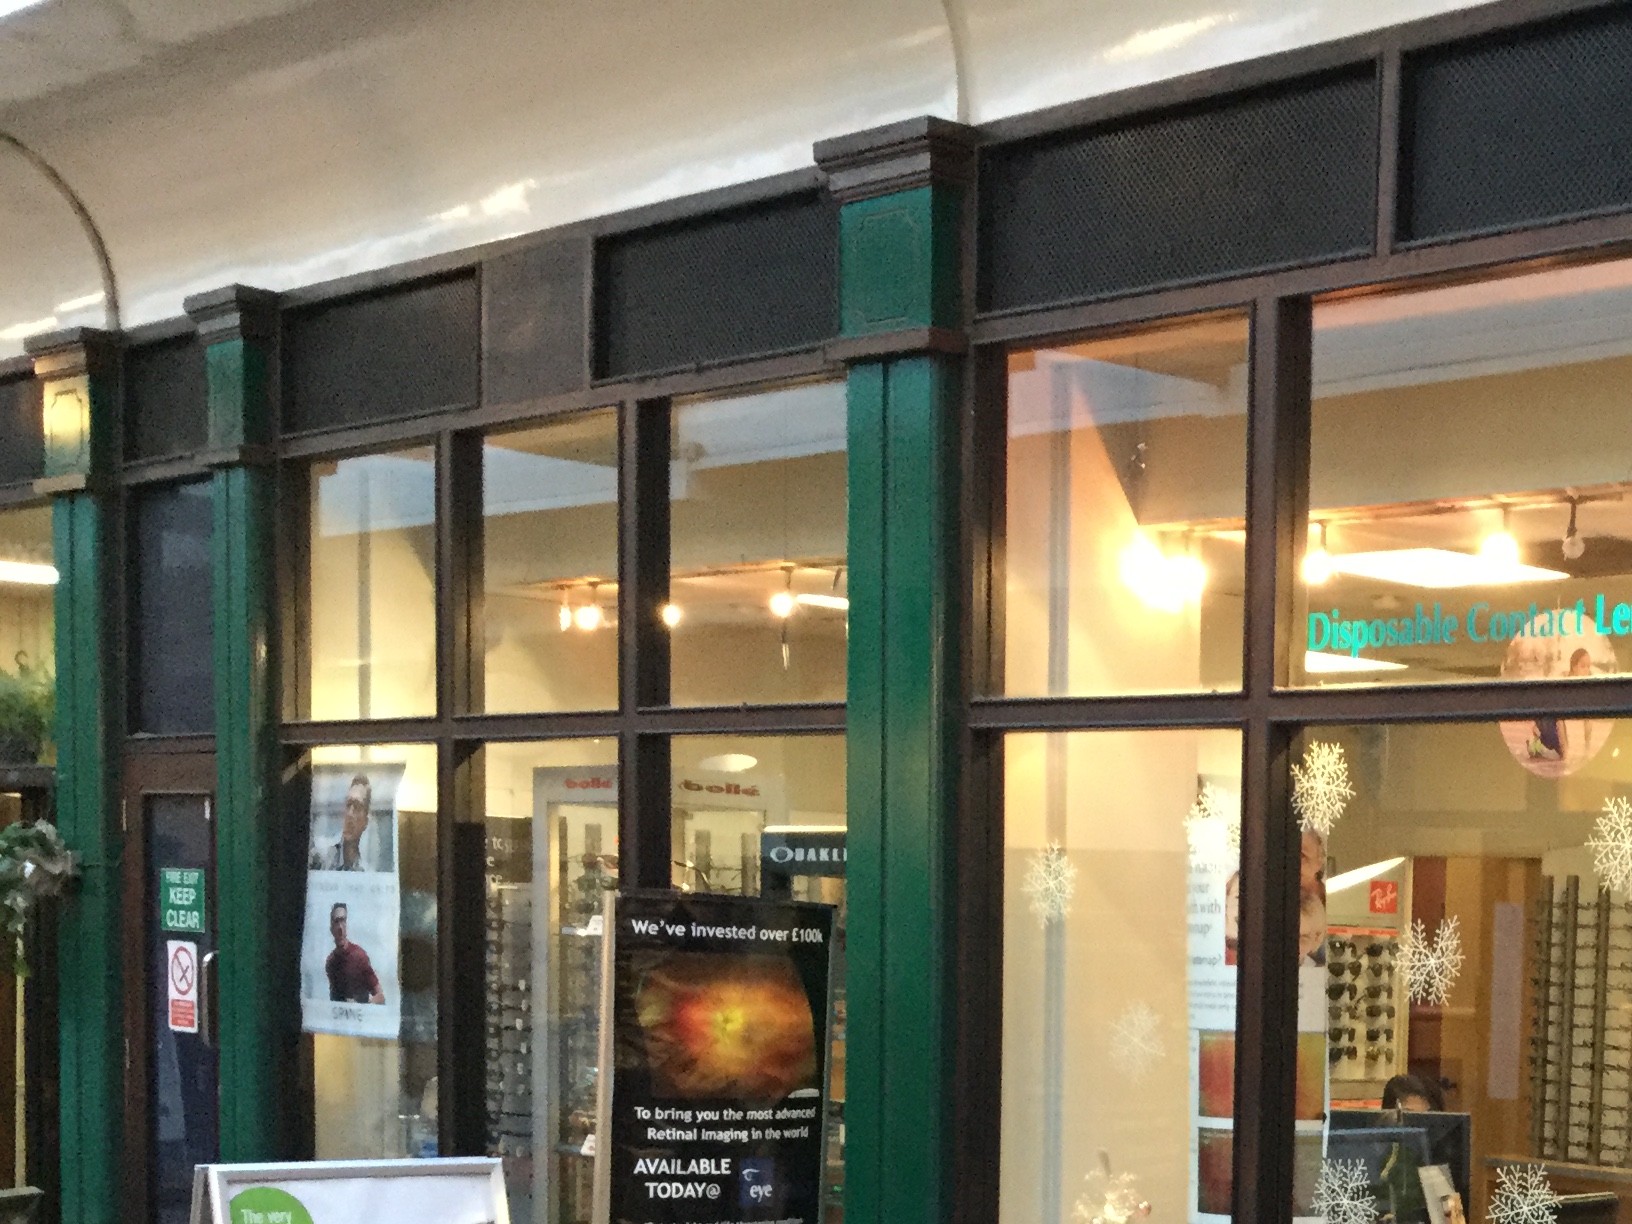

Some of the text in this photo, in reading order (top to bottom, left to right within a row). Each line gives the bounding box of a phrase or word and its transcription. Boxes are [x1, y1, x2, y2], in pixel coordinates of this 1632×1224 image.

[1308, 602, 1459, 658] Disposable
[1467, 599, 1586, 642] Contact
[169, 887, 197, 905] KEEP
[166, 908, 200, 929] CLEAR
[691, 921, 756, 940] invested
[759, 928, 789, 942] over
[634, 1106, 816, 1123] To bring you the most advanced
[647, 1126, 809, 1143] Retinal Imaging in the world
[633, 1158, 732, 1176] AVAILABLE
[644, 1181, 721, 1200] TODAY@
[750, 1183, 773, 1204] eye
[240, 1208, 264, 1224] The
